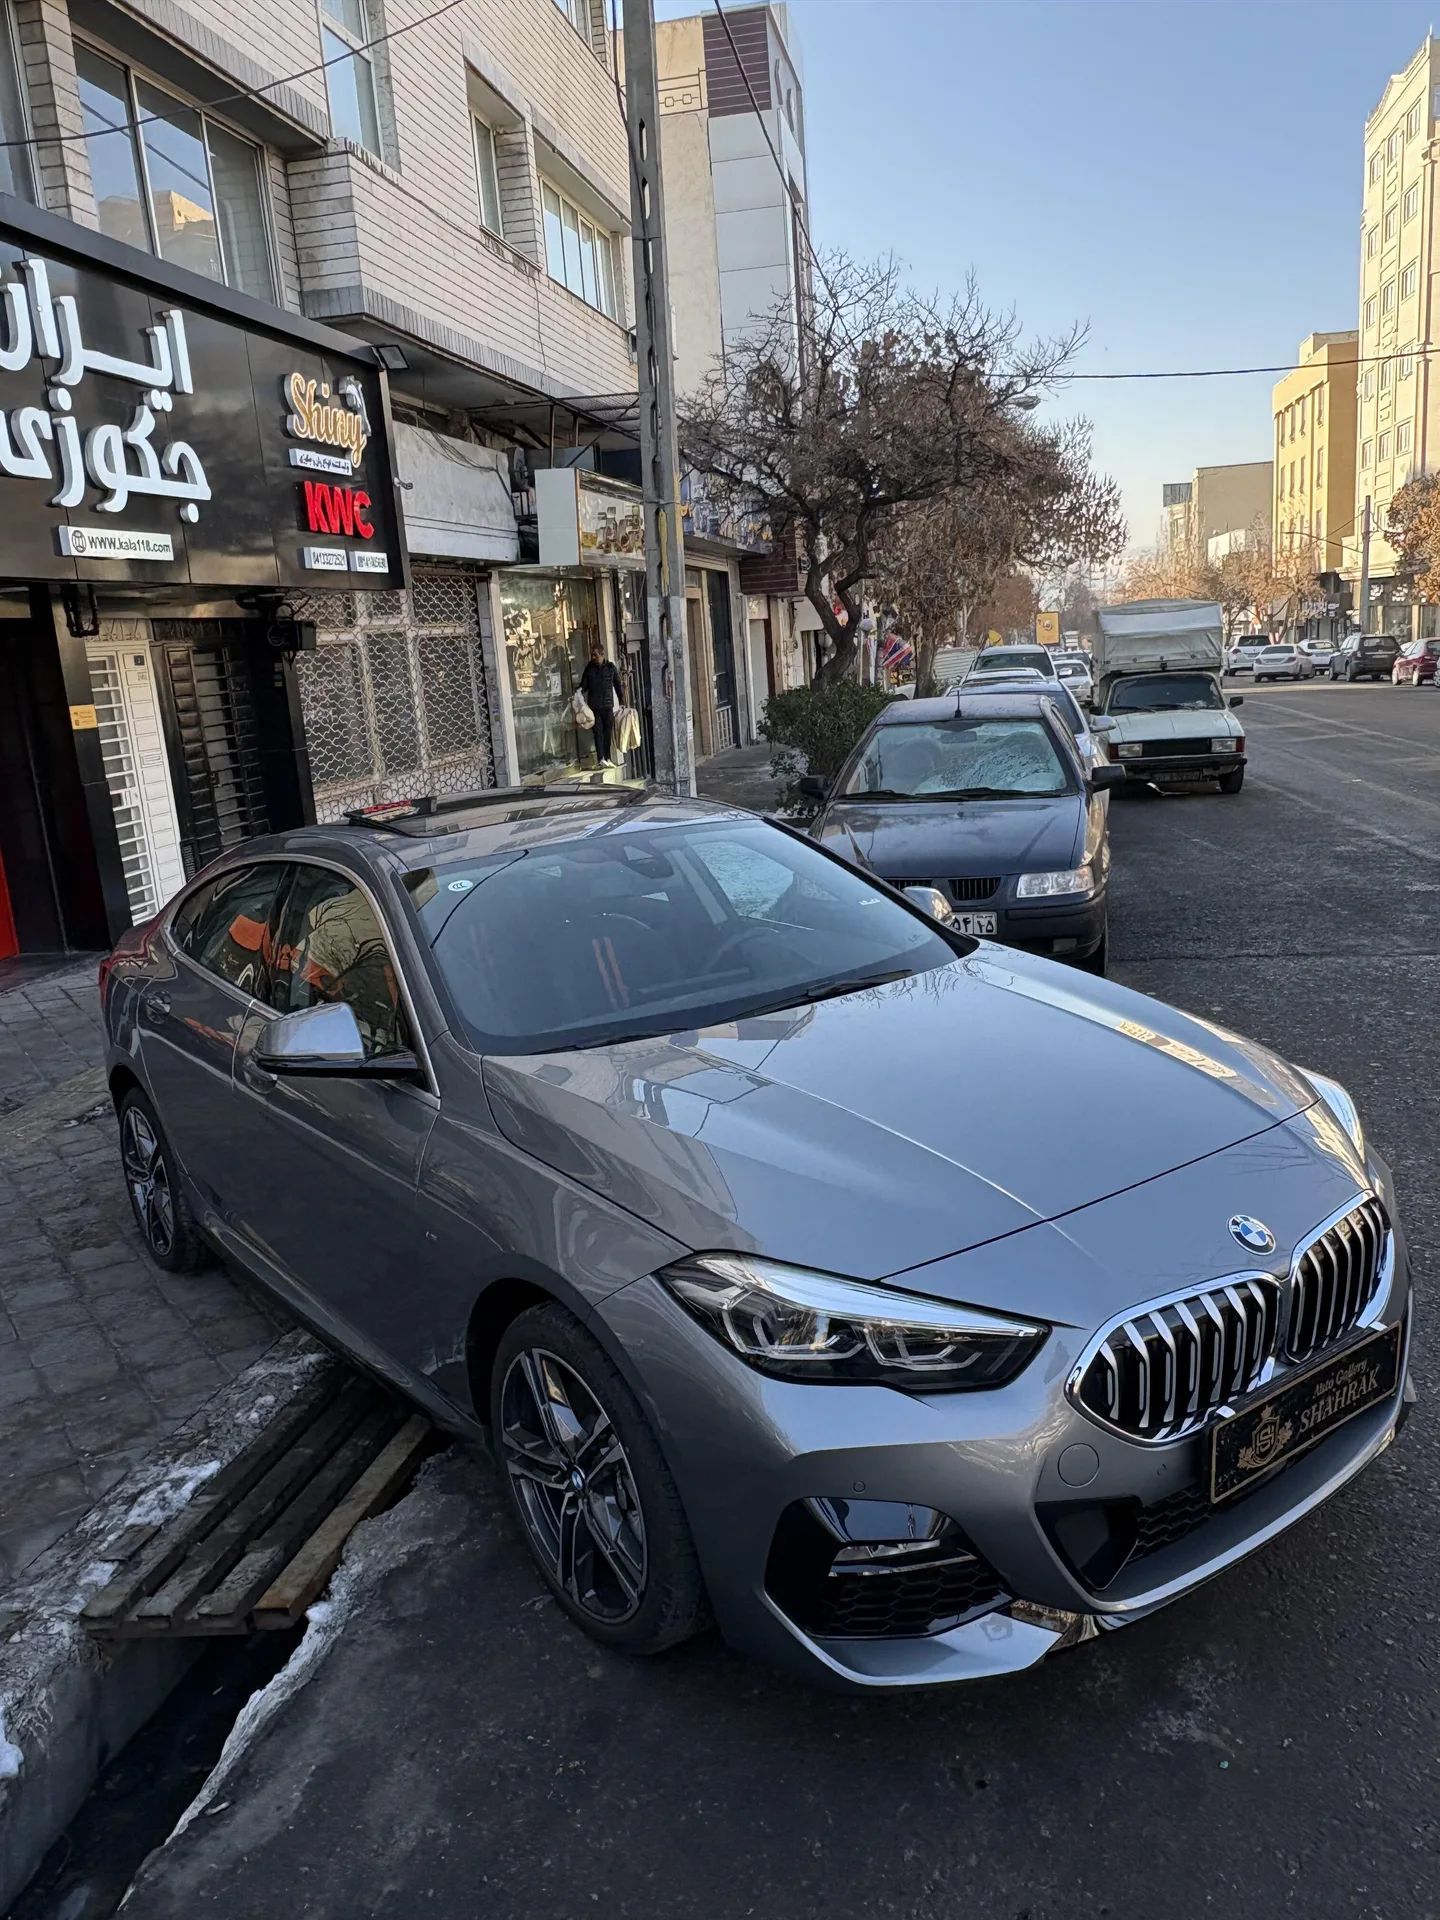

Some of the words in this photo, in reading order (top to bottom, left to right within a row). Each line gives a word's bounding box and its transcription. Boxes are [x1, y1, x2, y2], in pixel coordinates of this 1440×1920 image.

[290, 372, 367, 468] Shiny
[303, 480, 375, 540] KWC
[1299, 1364, 1380, 1433] SHAHRAK
